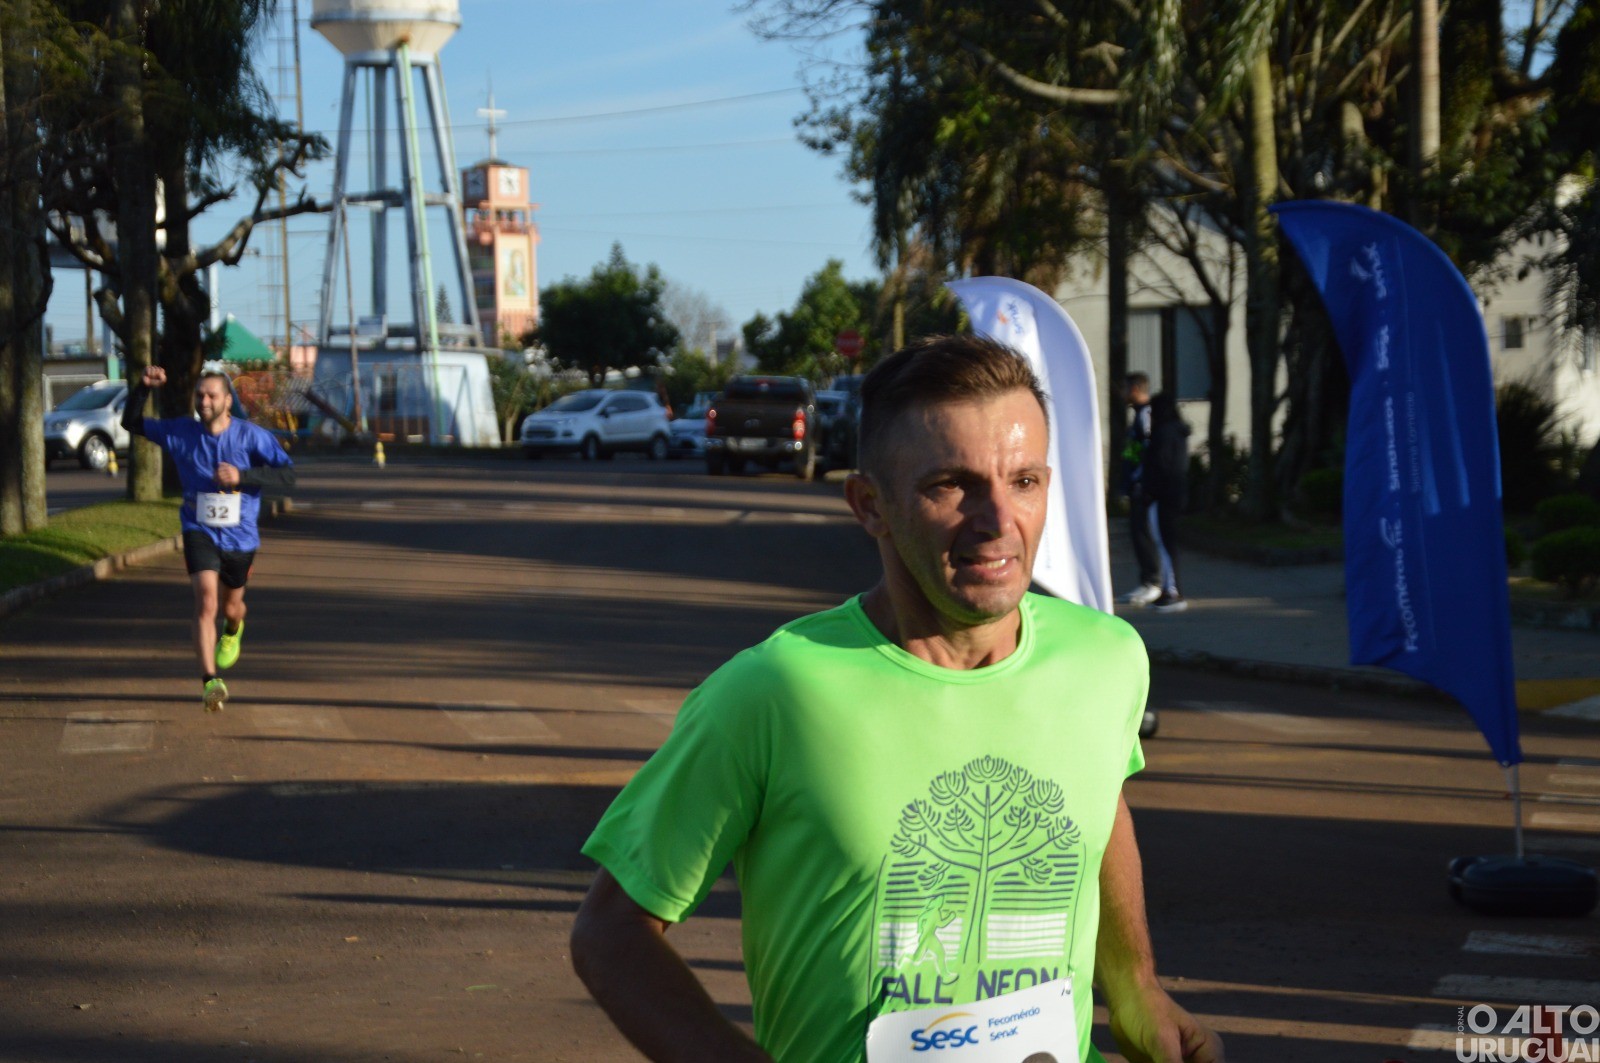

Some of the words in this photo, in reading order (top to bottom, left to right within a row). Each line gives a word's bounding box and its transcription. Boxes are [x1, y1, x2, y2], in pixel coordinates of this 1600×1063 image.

[206, 505, 229, 518] 32
[1394, 548, 1418, 651] Fecomércio
[882, 972, 954, 1005] FALL
[988, 1007, 1040, 1027] Fecomércio
